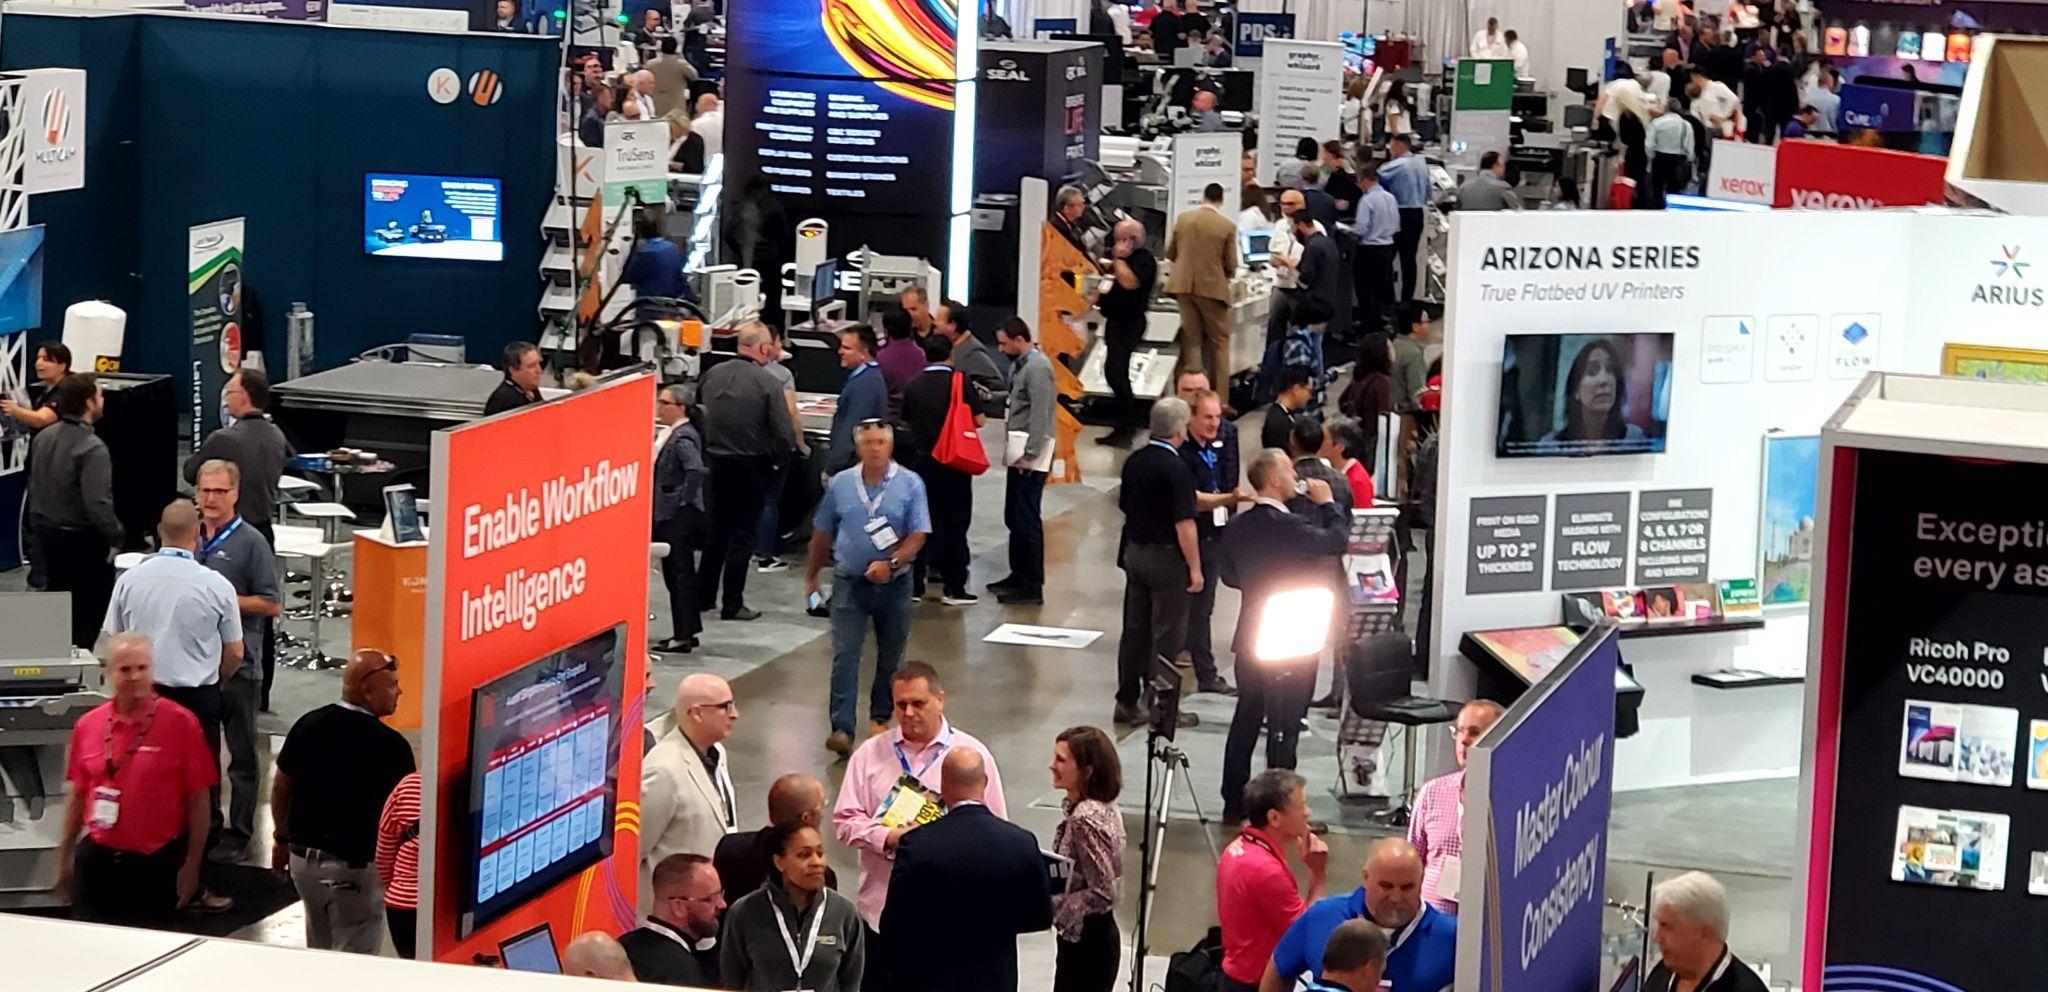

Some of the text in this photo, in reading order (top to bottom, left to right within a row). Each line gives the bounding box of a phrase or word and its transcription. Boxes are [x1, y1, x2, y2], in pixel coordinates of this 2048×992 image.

[1240, 23, 1276, 41] PDS
[986, 68, 1031, 81] SEAL
[616, 147, 655, 162] TruSens
[1720, 176, 1765, 196] xerox
[1481, 245, 1700, 270] ARIZONA SERIES
[1481, 281, 1685, 301] True Flatbed UV Printers
[1971, 284, 2044, 307] ARIUS
[1834, 356, 1873, 367] FLOW
[193, 361, 202, 404] Laird
[463, 459, 640, 559] Enable Workflow
[1640, 508, 1710, 522] CONFIGURATIONS
[1502, 515, 1516, 526] ON
[1571, 512, 1614, 524] ELIMINATE
[1493, 527, 1522, 538] MEDIA
[1561, 523, 1622, 536] MASKING WITH
[1680, 524, 1688, 535] 7
[1688, 523, 1705, 535] OR
[1916, 512, 2048, 553] Excepti
[1476, 544, 1498, 560] UP
[1499, 543, 1519, 559] TO
[1571, 540, 1612, 556] FLOW
[1640, 538, 1707, 552] 8 CHANNELS
[1478, 560, 1534, 574] THICKNESS
[1557, 556, 1624, 572] TECHNOLOGY
[1637, 553, 1707, 567] INCLUDING WHITE
[1644, 566, 1699, 578] AND VARNISH
[1913, 555, 2007, 590] every
[461, 556, 587, 642] Intelligence
[1909, 637, 2010, 664] Ricoh Pro
[1906, 662, 2005, 690] VC40000
[1513, 732, 1605, 879] Master Colour
[1521, 832, 1599, 971] Consistency
